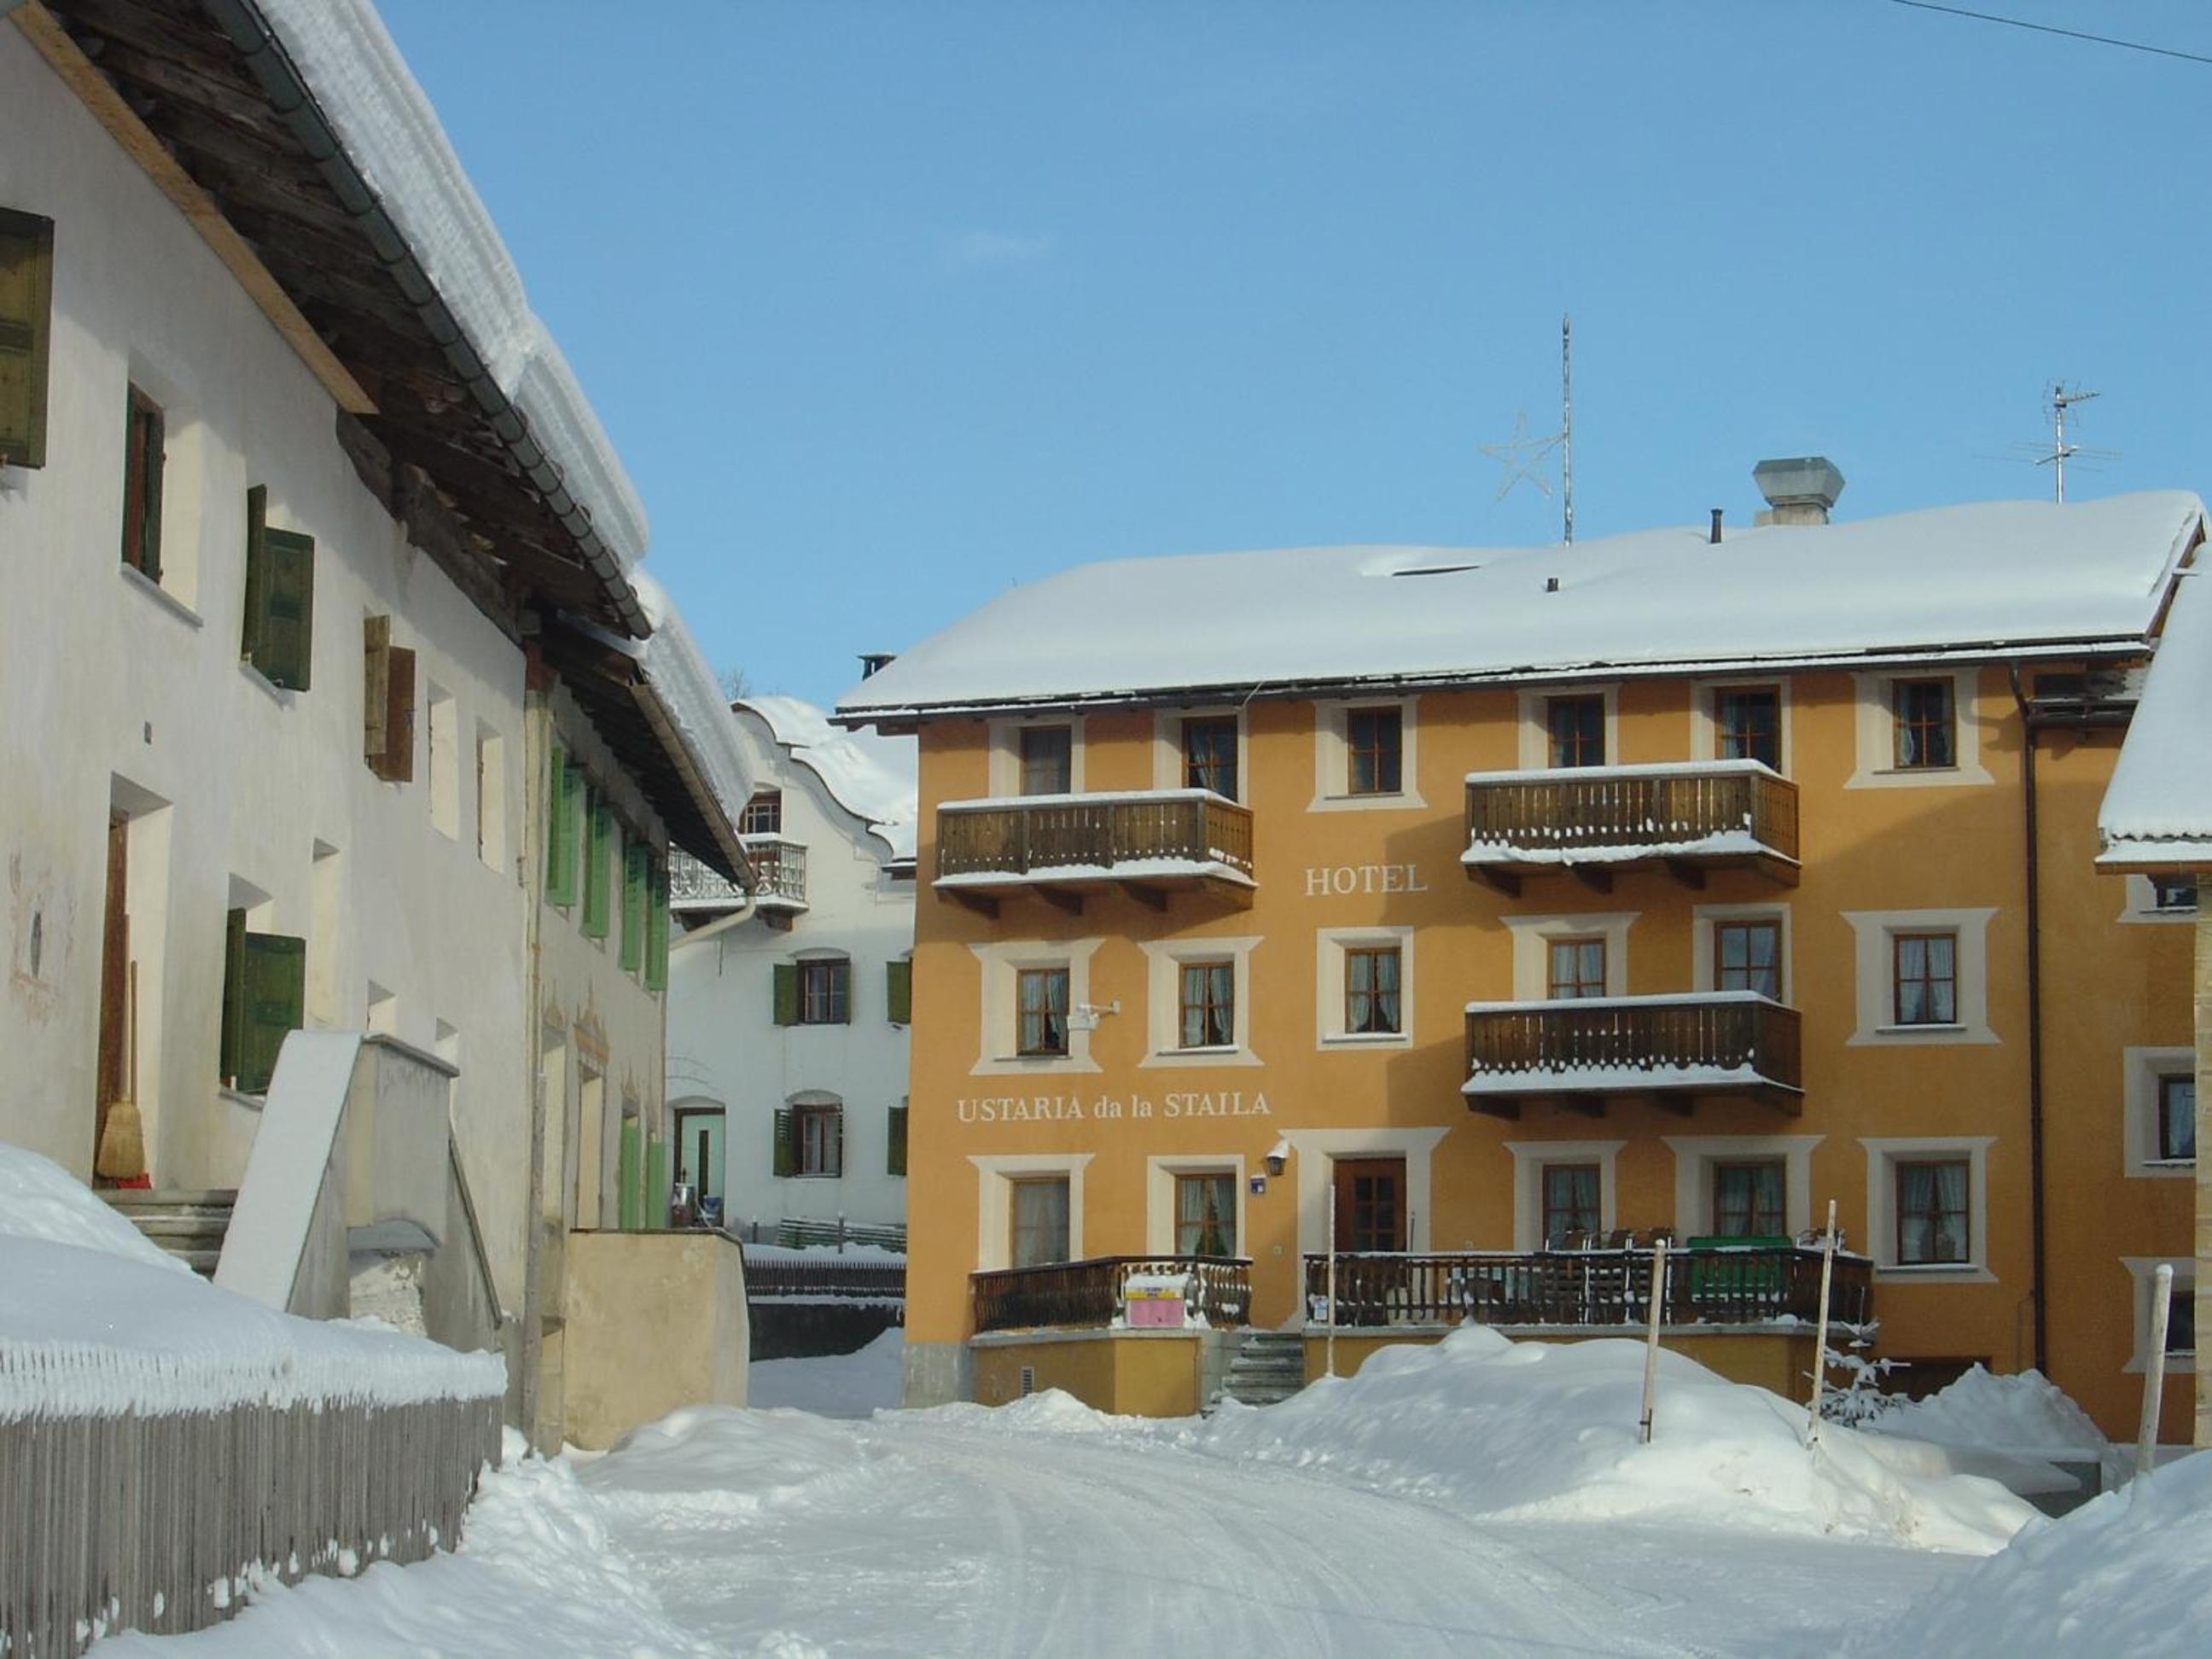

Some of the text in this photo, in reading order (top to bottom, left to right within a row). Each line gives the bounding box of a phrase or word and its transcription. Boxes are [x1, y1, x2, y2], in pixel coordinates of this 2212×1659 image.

[1305, 864, 1429, 896] HOTEL
[957, 1092, 1272, 1122] USTARIA da la STAILA
